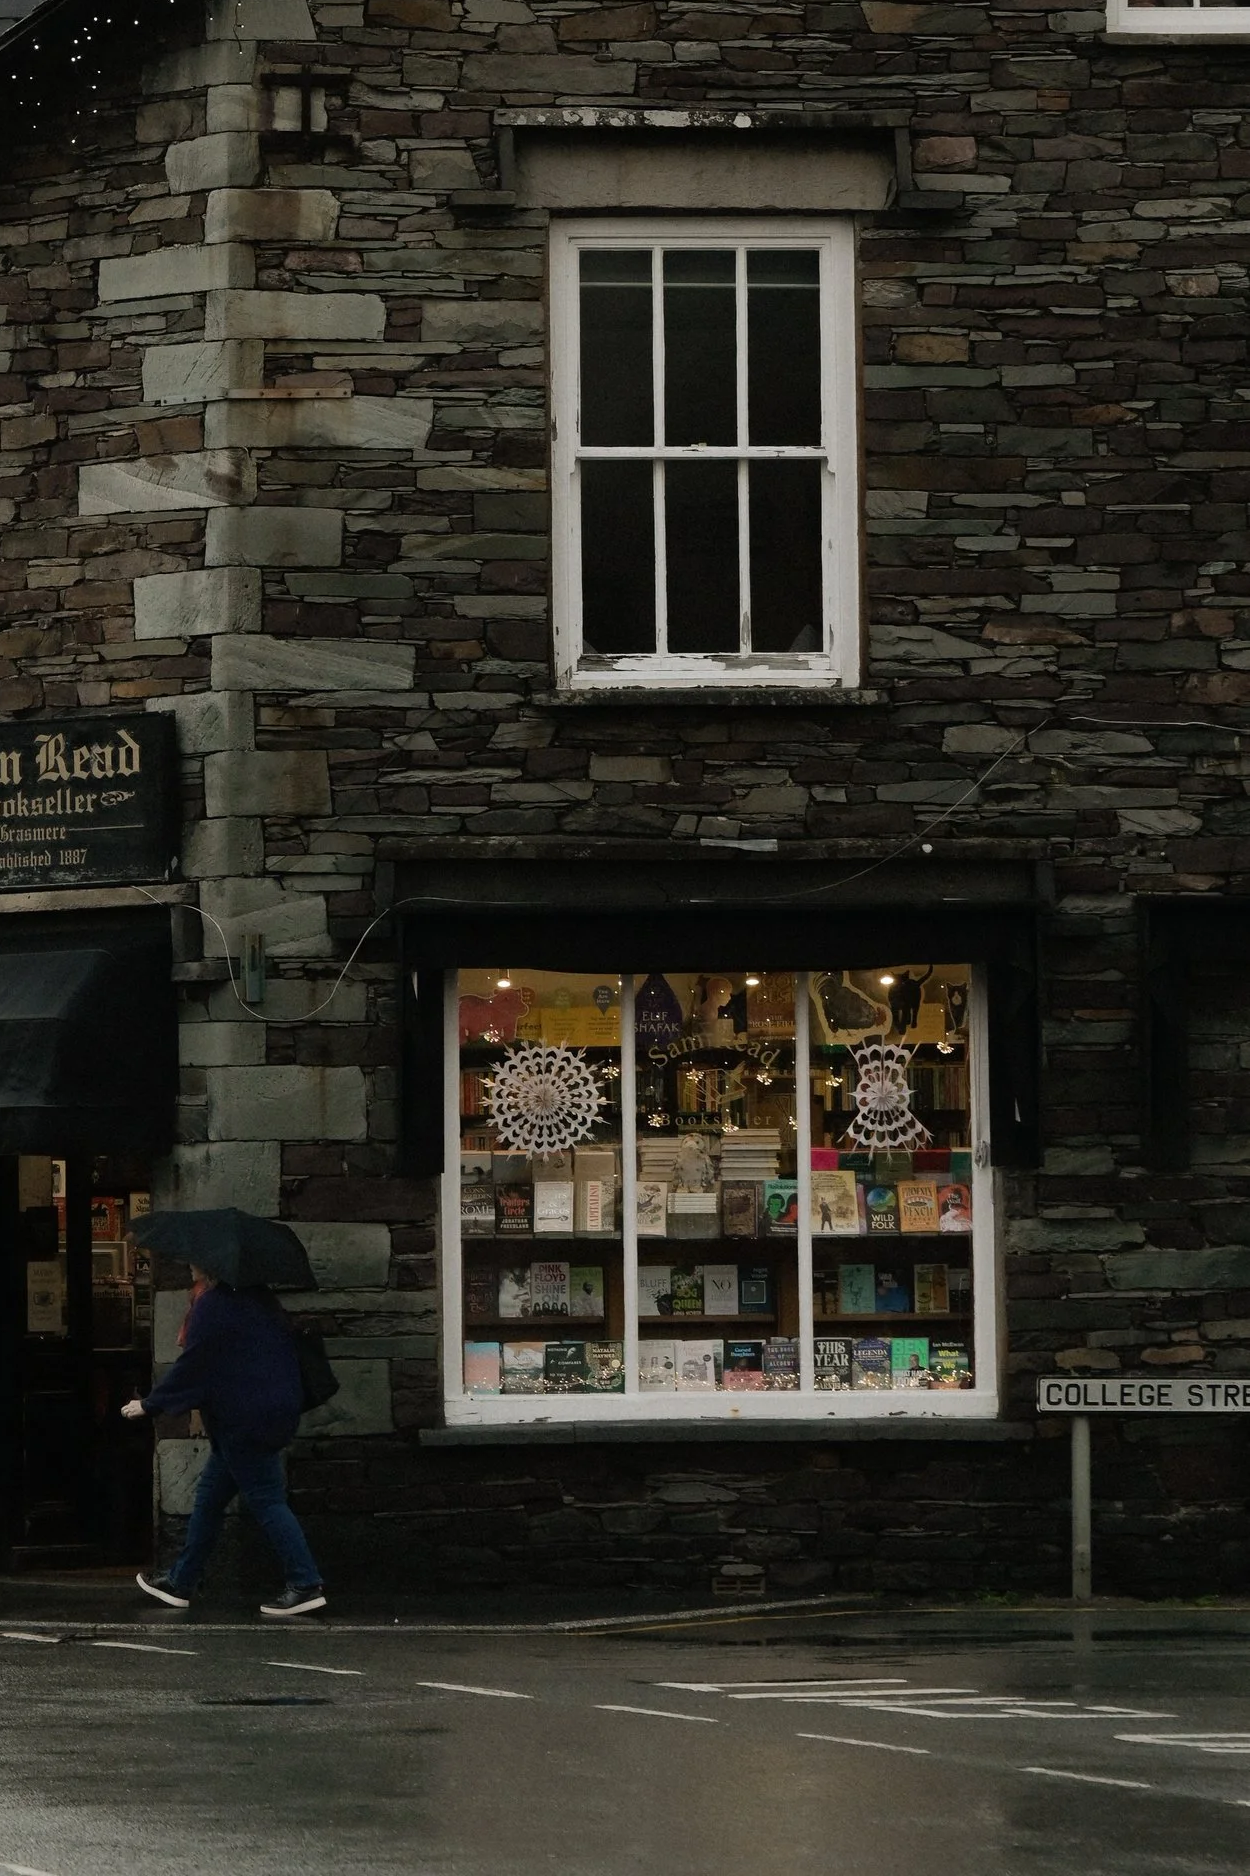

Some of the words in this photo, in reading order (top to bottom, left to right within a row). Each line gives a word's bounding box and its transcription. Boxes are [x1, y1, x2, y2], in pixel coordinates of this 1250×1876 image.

[34, 729, 140, 782] Read
[59, 848, 88, 866] 1887
[642, 1011, 669, 1022] ELIF
[634, 1022, 680, 1033] SHAFAK
[648, 1034, 704, 1069] Sam
[590, 1184, 599, 1228] CAPITALISM
[871, 1214, 894, 1222] WILD
[538, 1264, 562, 1272] PINK
[534, 1274, 566, 1282] FLOYD
[640, 1279, 667, 1288] BLUFF
[534, 1284, 566, 1294] SHINE
[542, 1294, 559, 1302] ON
[672, 1299, 702, 1310] QUEEN
[816, 1341, 846, 1354] THIS
[894, 1340, 928, 1354] BEN
[814, 1354, 850, 1366] YEAR
[942, 1360, 956, 1369] We
[1046, 1383, 1172, 1406] COLLEGE
